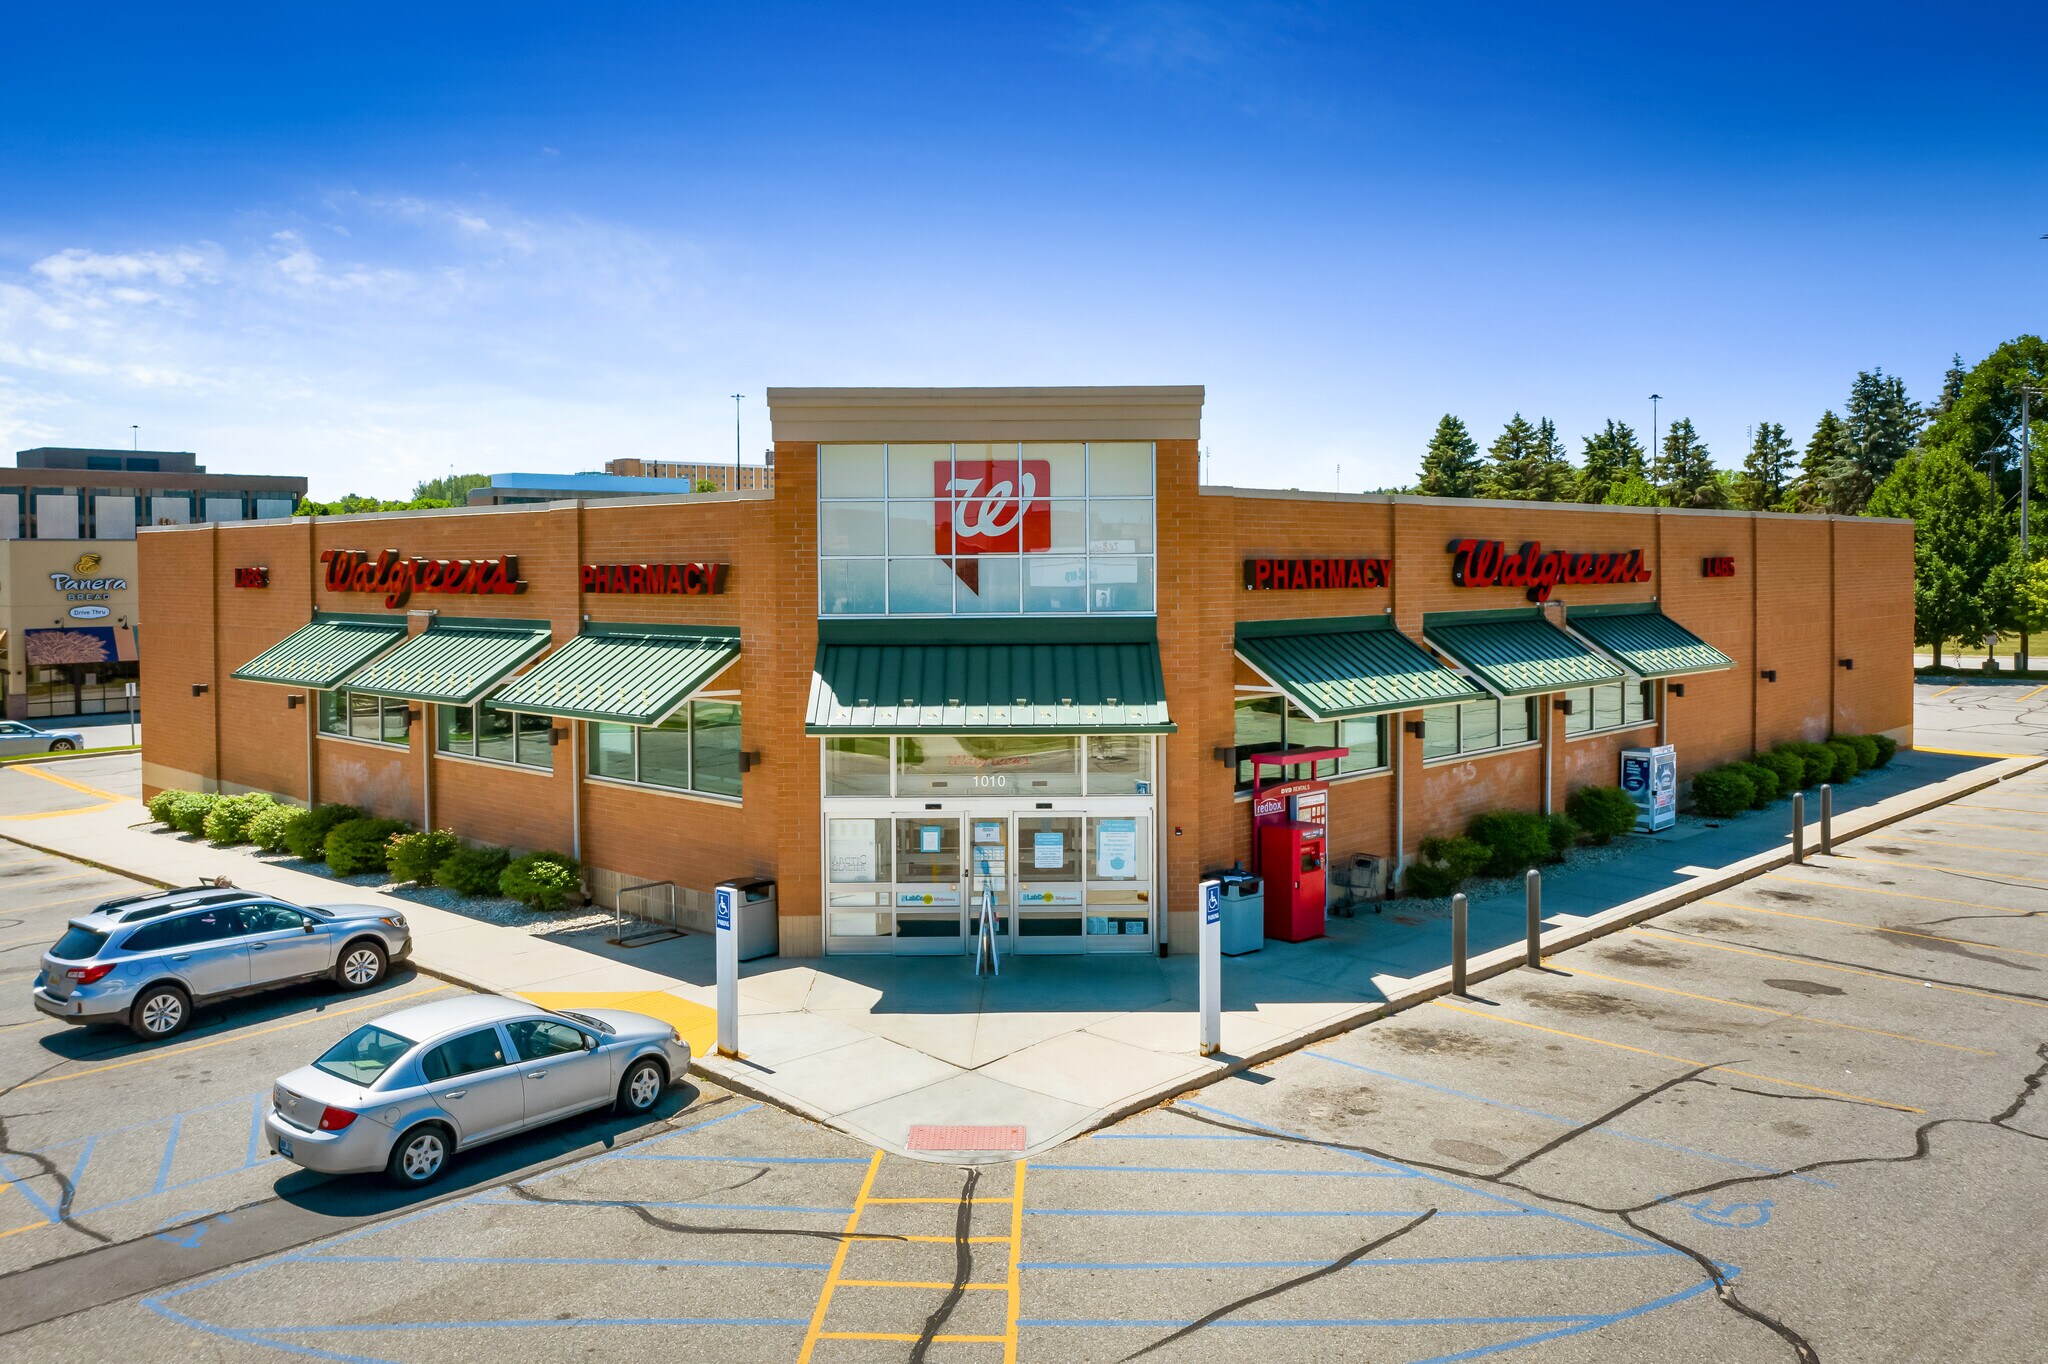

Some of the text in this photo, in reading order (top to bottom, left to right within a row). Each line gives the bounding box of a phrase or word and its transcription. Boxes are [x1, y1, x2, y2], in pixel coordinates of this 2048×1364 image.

[1255, 559, 1393, 590] PHARMACY
[1454, 538, 1652, 602] Walgreens
[1705, 556, 1735, 577] LABS
[50, 573, 127, 591] Panera
[235, 567, 265, 588] LABS
[320, 549, 522, 609] Walgreens
[581, 563, 722, 595] PHARMACY
[973, 775, 1006, 787] 1010
[1293, 784, 1310, 792] RENTALS
[1257, 801, 1282, 813] redbox
[831, 854, 867, 865] ARCTIC
[831, 864, 866, 872] GLACIER
